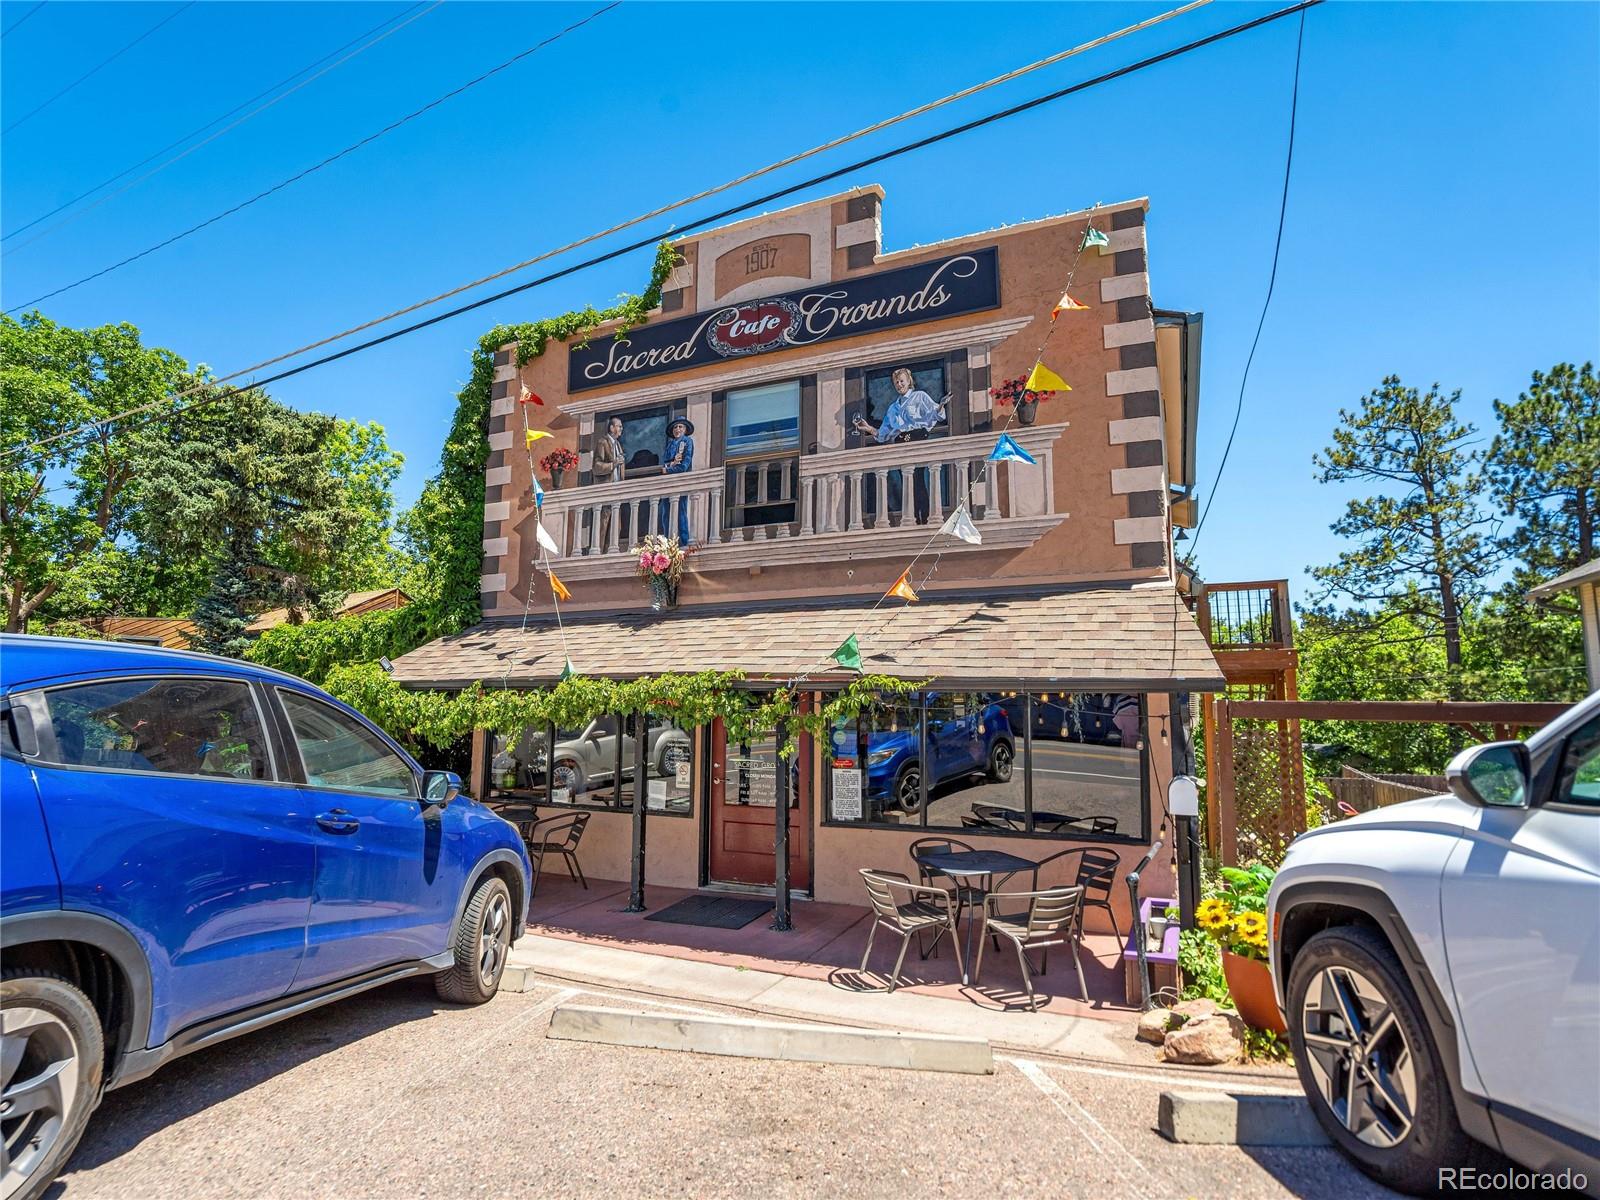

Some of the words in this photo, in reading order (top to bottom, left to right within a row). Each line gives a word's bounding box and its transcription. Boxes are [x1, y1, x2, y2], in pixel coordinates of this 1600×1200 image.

[744, 248, 778, 275] 1907
[584, 308, 739, 380] Sacred
[784, 256, 978, 345] Grounds
[729, 315, 781, 338] Cafe
